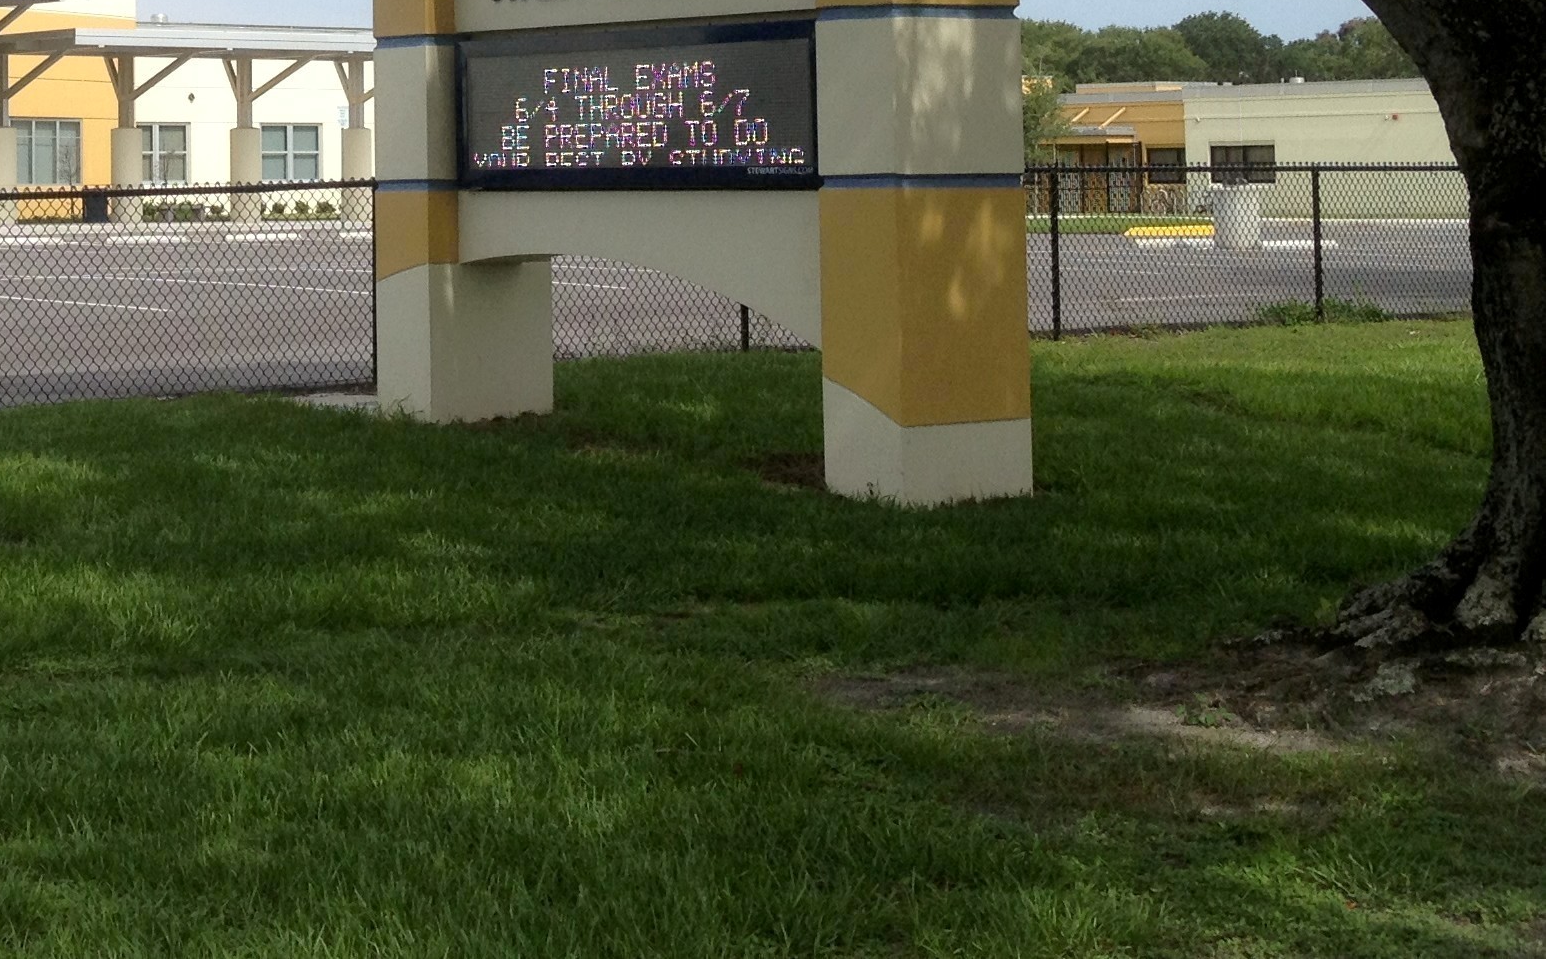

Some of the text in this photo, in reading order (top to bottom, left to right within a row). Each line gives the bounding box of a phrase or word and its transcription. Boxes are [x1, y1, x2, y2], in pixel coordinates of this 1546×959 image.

[544, 60, 716, 94] FINAL EXAMS
[515, 88, 750, 122] 6/4 THROUGH 6/7
[501, 117, 769, 150] BE PREPARED TO DO
